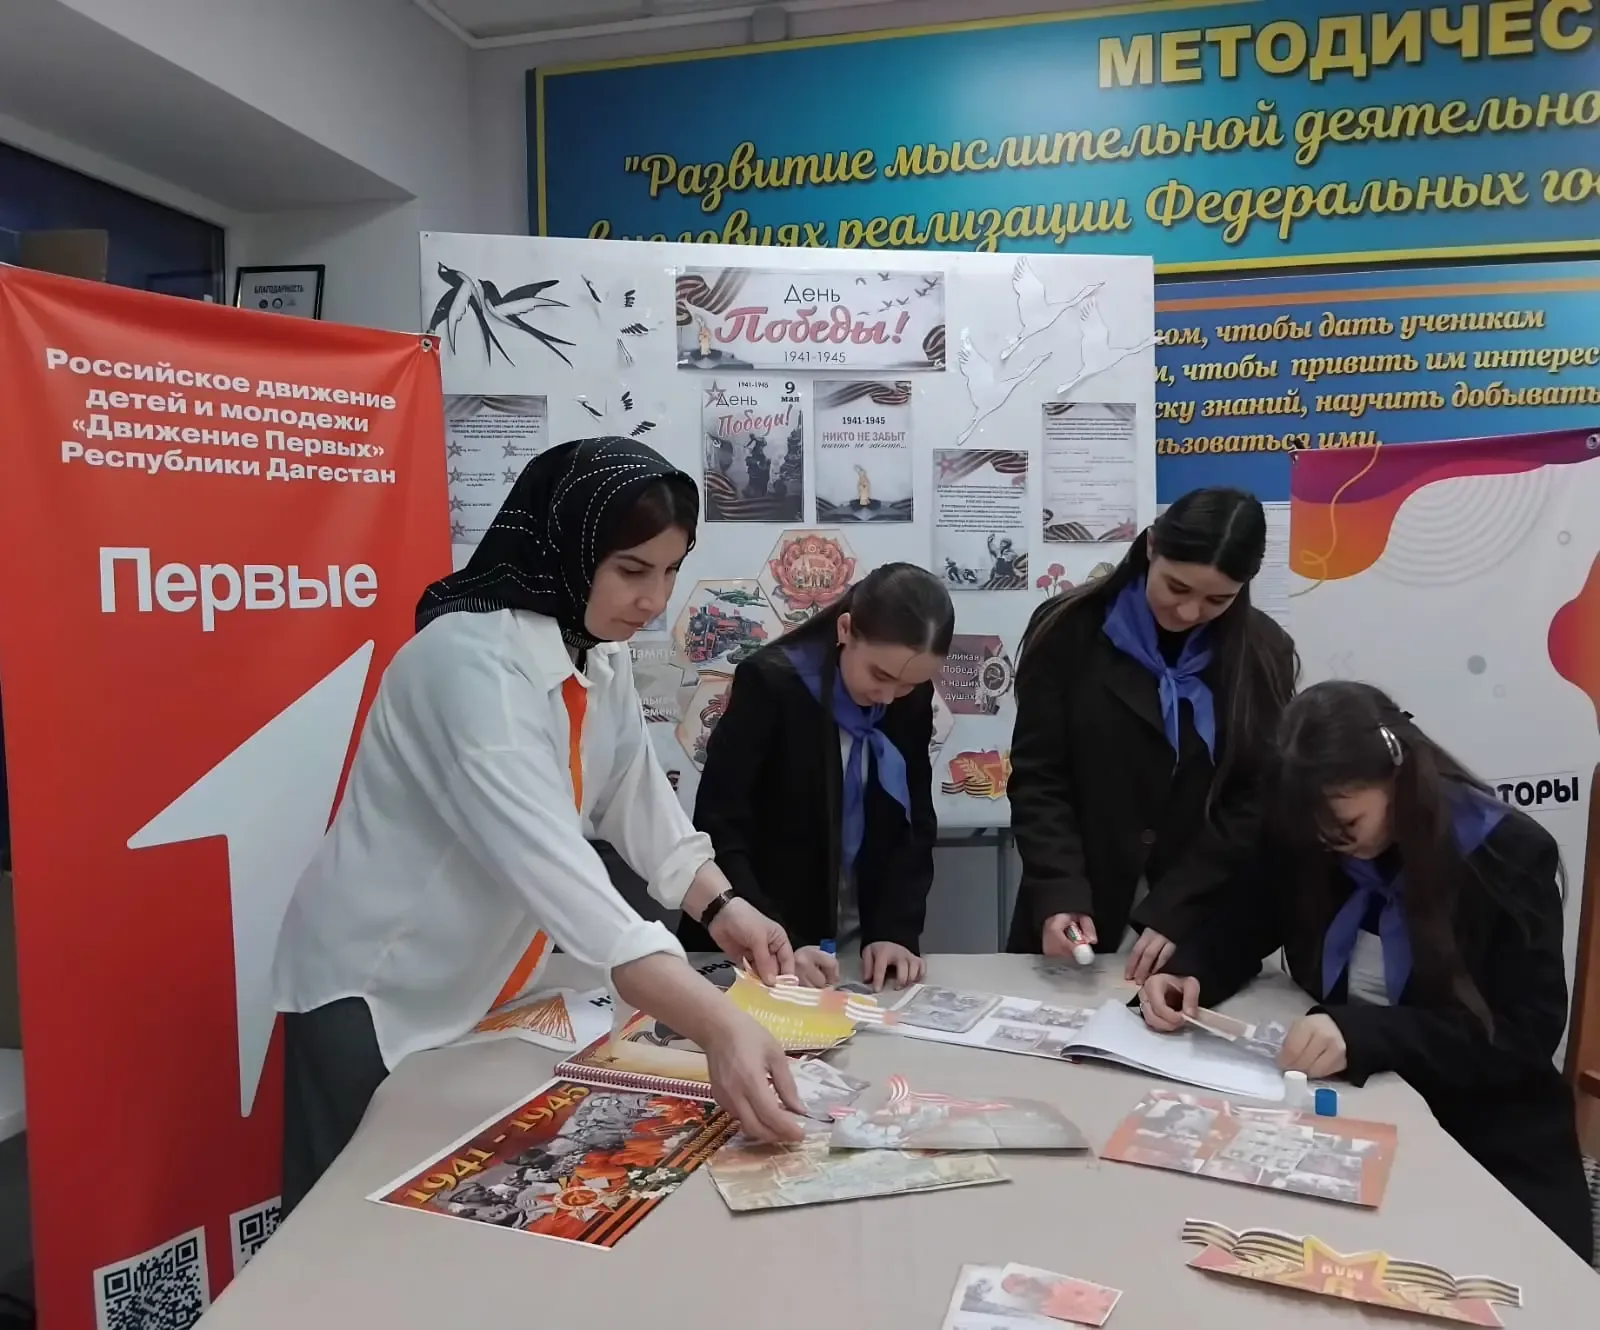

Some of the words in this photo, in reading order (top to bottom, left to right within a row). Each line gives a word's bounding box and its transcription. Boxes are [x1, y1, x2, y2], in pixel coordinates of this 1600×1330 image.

[1098, 0, 1593, 88] МЕТОДИЧЕС
[624, 142, 877, 212] "Развитие
[885, 100, 1285, 178] мыслительной
[1295, 90, 1600, 165] деятельно
[837, 195, 1132, 253] реализации
[1145, 171, 1529, 244] Федеральных
[1540, 167, 1600, 203] го
[784, 284, 840, 304] День
[715, 305, 910, 344] Победы!
[1215, 314, 1312, 343] чтобы
[1319, 311, 1394, 338] дать
[1400, 306, 1545, 338] ученикам
[784, 351, 846, 363] 1941-1945
[1182, 354, 1278, 382] чтобы
[1291, 355, 1418, 379] привить
[1426, 350, 1467, 371] им
[1473, 346, 1600, 373] интерес
[45, 348, 250, 392] Российское
[256, 378, 397, 410] движение
[784, 381, 796, 394] 9
[85, 389, 187, 414] детей
[194, 399, 213, 417] и
[220, 402, 369, 432] молодежи
[716, 393, 758, 406] День
[1201, 388, 1307, 418] знаний,
[1316, 387, 1444, 418] научить
[1452, 380, 1600, 408] добывать
[73, 413, 258, 449] «Движение
[265, 430, 385, 458] Первых»
[822, 431, 855, 441] НИКТО
[857, 431, 871, 441] НЕ
[872, 431, 906, 441] ЗАБЫТ
[842, 416, 886, 425] 1941-1945
[61, 441, 260, 477] Республики
[266, 458, 396, 484] Дагестан
[99, 547, 378, 632] Первые
[404, 1147, 495, 1204] 1941
[511, 1083, 591, 1133] 1945
